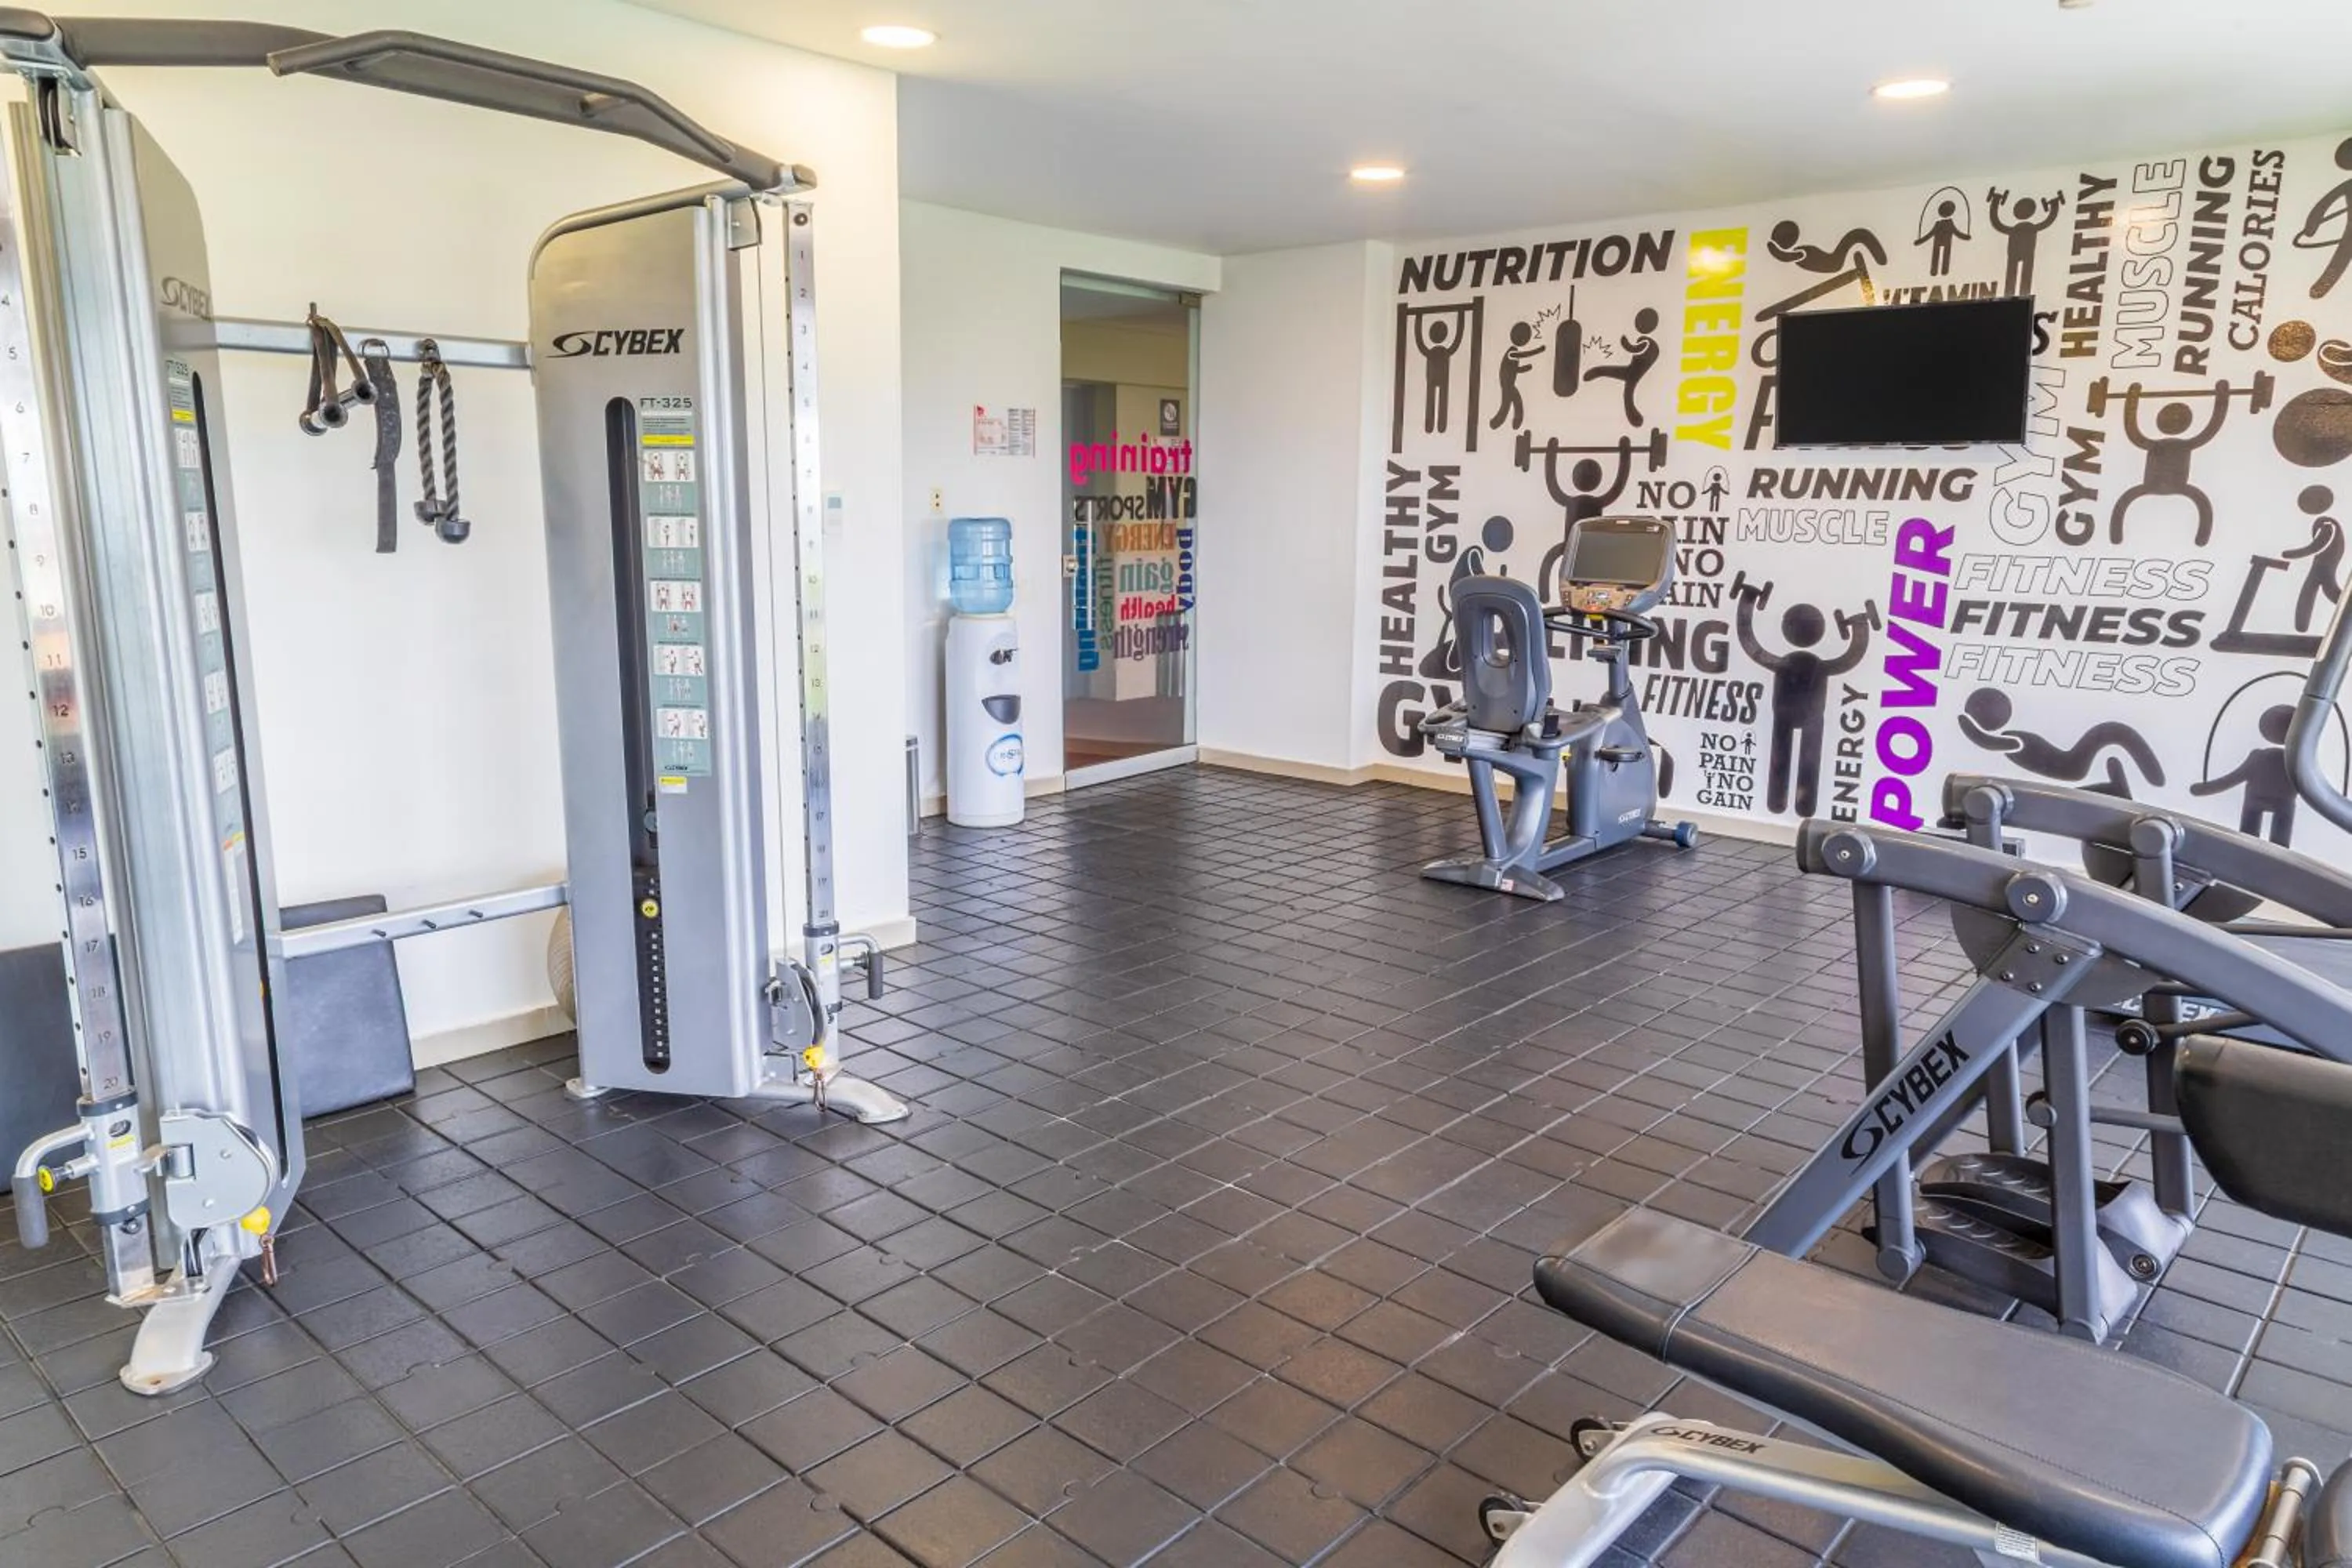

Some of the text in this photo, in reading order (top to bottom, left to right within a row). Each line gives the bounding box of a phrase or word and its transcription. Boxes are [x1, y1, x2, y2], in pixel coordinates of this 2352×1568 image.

[1398, 230, 1675, 294] NUTRITION
[2111, 158, 2186, 368] MUSCLE
[2228, 150, 2285, 350] CALORIES
[2060, 173, 2117, 358] HEALTHY
[2174, 155, 2235, 376] RUNNING
[592, 328, 684, 356] CYBEX
[1675, 226, 1748, 451] ENERGY
[8, 347, 17, 361] 5
[16, 401, 24, 414] 6
[640, 397, 692, 408] FT-325
[23, 452, 31, 463] 7
[1989, 365, 2066, 546] GYM
[1637, 481, 1696, 509] NO
[1747, 467, 1979, 502] RUNNING
[2056, 426, 2105, 546] GYM
[1425, 465, 1461, 563] GYM
[1737, 508, 1889, 545] MUSCLE
[1661, 516, 1730, 545] IN
[1380, 460, 1421, 676] HEALTHY
[1675, 548, 1724, 577] NO
[1954, 554, 2214, 601] FITNESS
[1659, 582, 1724, 608] AIN
[40, 604, 54, 616] 10
[1950, 600, 2205, 648] FITNESS
[47, 655, 61, 666] 11
[1870, 517, 1955, 832] POWER
[1944, 644, 2200, 696] FITNESS
[53, 705, 68, 717] 12
[1642, 673, 1764, 724] FITNESS
[1700, 732, 1737, 752] NO
[1831, 683, 1868, 823] ENERGY
[60, 752, 75, 764] 13
[1699, 752, 1756, 775] PAIN
[1717, 773, 1754, 792] NO
[1697, 789, 1754, 811] GAIN
[73, 848, 87, 860] 15
[79, 895, 94, 907] 16
[85, 941, 99, 953] 17
[92, 987, 106, 998] 18
[97, 1031, 111, 1044] 19
[103, 1076, 118, 1090] 20
[1874, 1029, 1970, 1135] CYBEX
[1679, 1429, 1766, 1454] CYBEX
